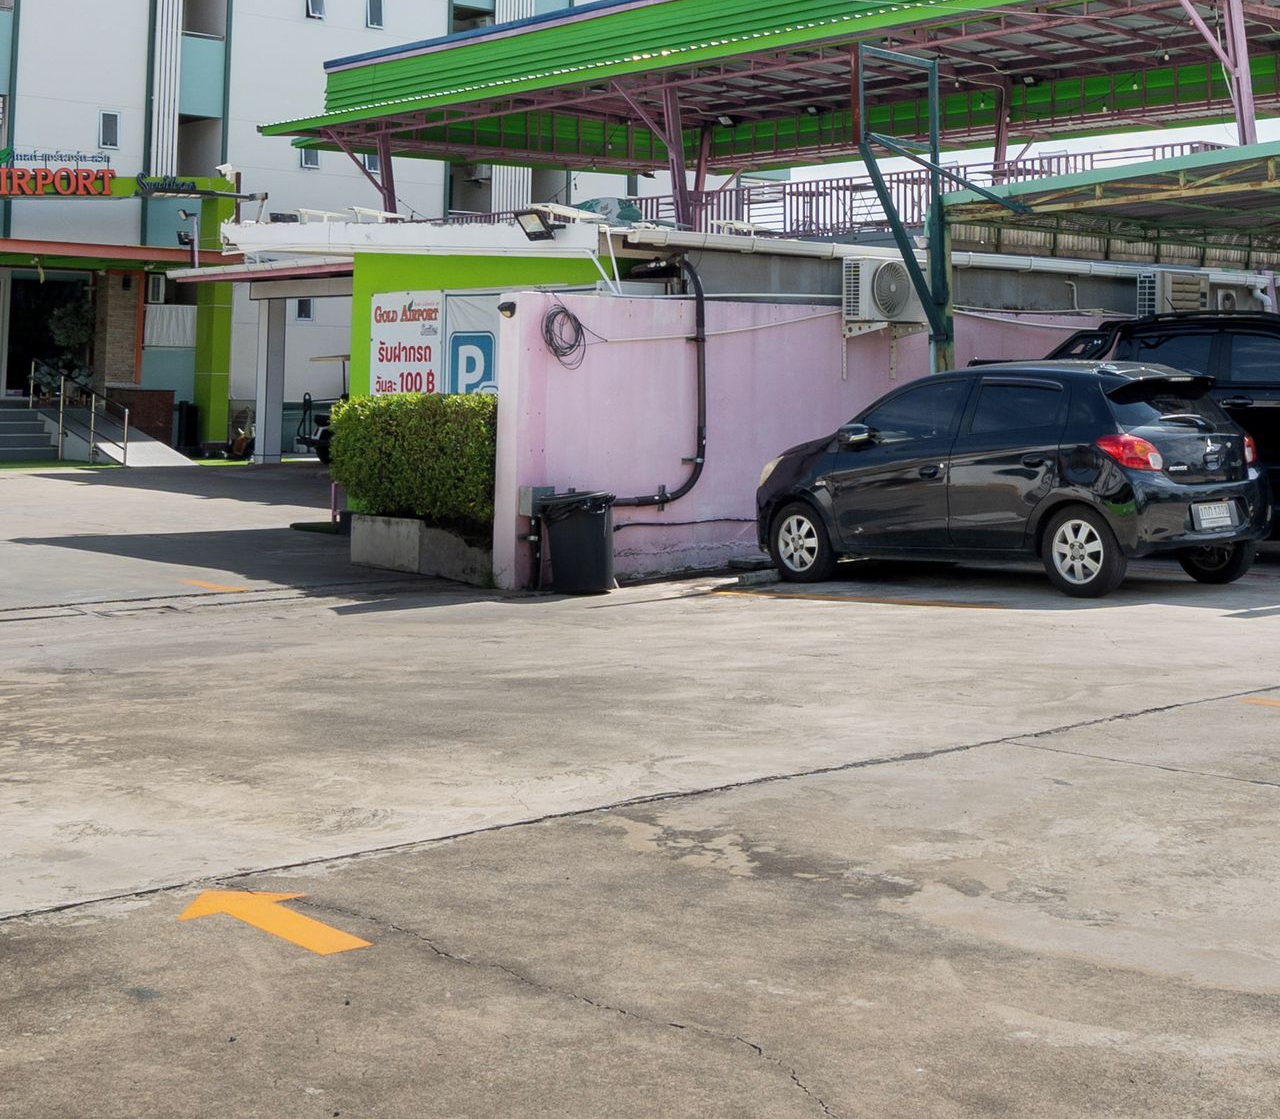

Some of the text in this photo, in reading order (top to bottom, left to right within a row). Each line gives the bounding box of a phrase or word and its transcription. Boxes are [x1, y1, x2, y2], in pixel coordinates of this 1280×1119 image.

[378, 340, 432, 363] รับฝากรถ
[375, 375, 397, 393] วันละ
[399, 371, 422, 393] 100
